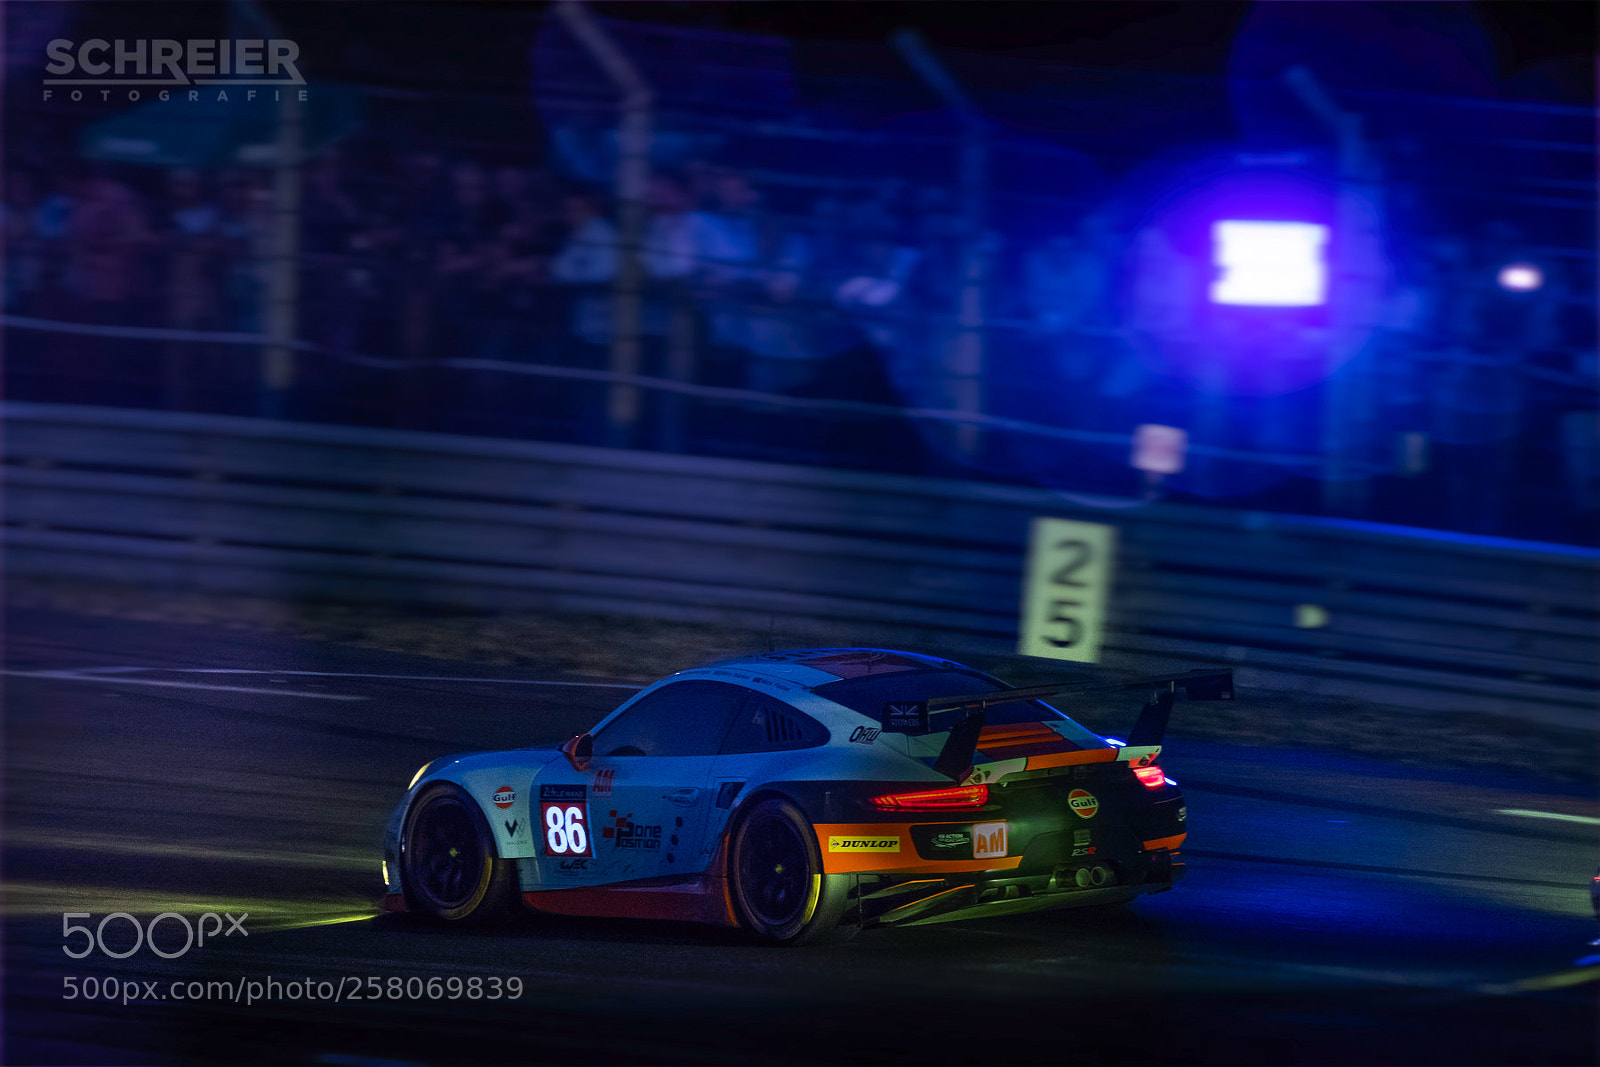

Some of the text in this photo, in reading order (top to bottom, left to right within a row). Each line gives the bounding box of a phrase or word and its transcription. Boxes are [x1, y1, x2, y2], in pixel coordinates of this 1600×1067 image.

[493, 791, 516, 802] Gulf
[1070, 797, 1096, 808] Gulf
[546, 806, 587, 854] 86
[841, 840, 898, 848] DUNLOP
[976, 828, 1004, 854] AM
